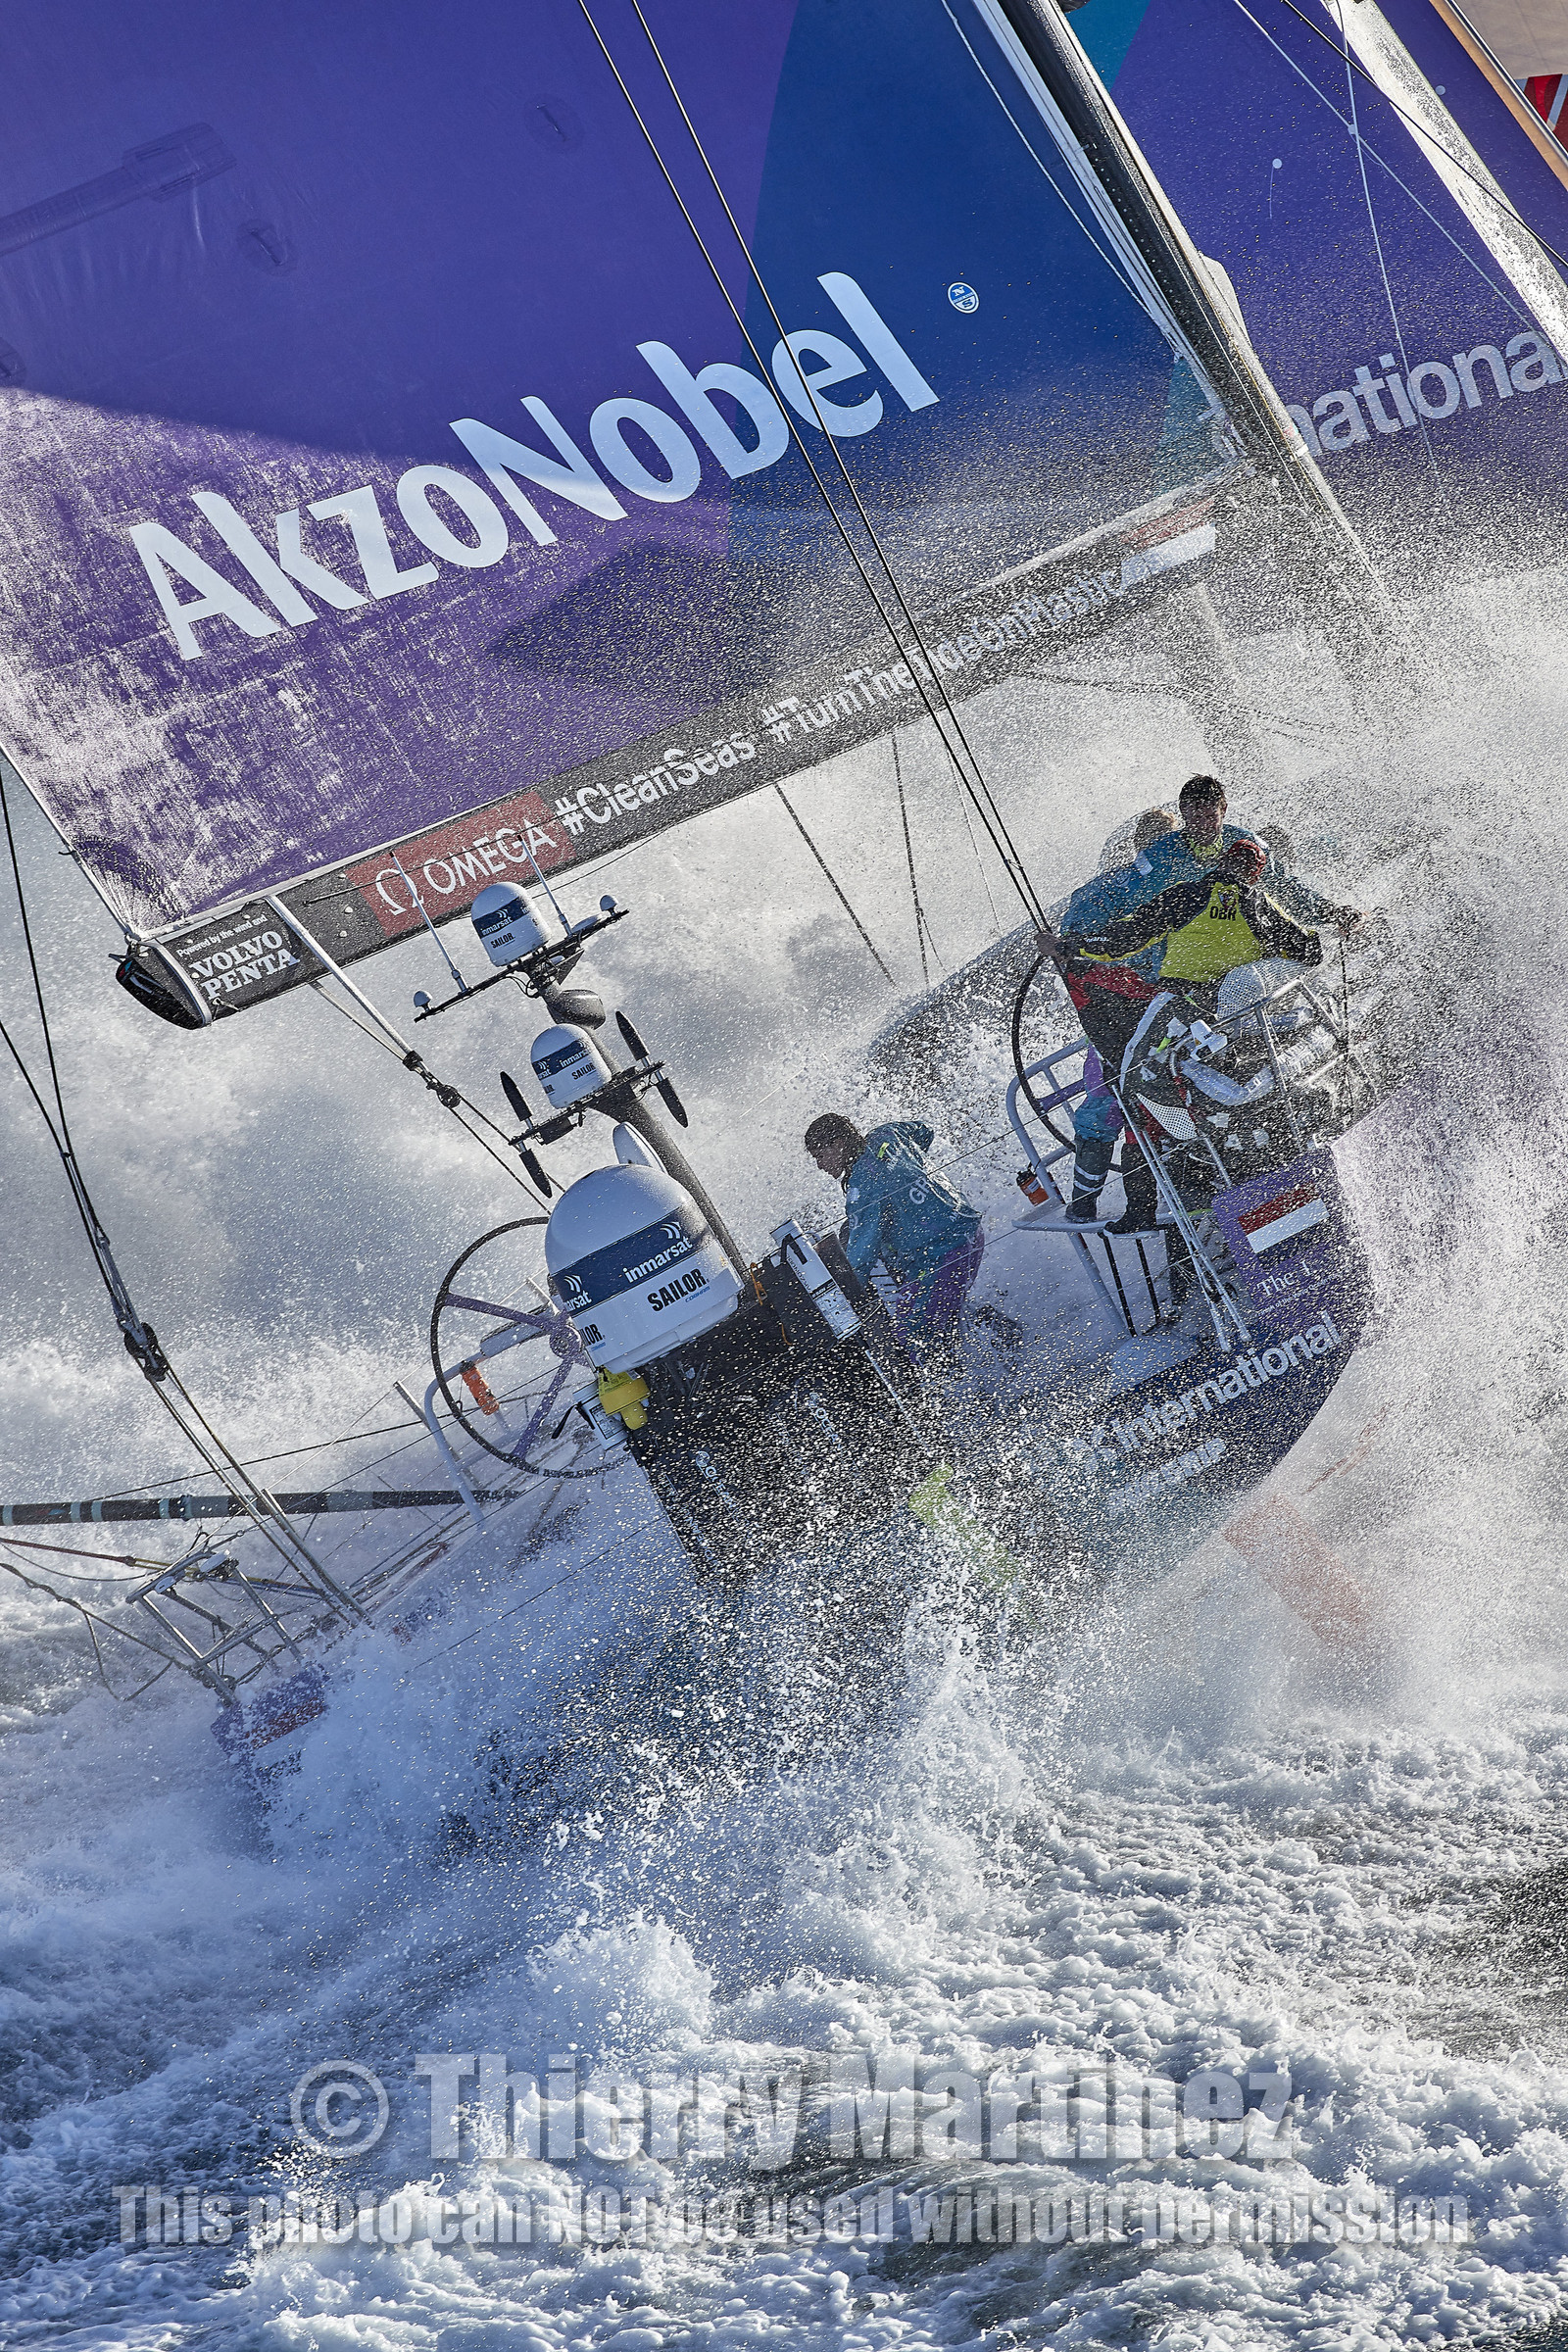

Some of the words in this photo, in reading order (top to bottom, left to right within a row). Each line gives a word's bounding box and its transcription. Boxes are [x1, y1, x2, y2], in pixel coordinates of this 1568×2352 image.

[1285, 330, 1568, 457] nationa
[129, 271, 939, 661] AkzoNobel
[423, 819, 557, 894] OMEGA
[555, 733, 756, 835] #CleanSeas
[176, 938, 212, 957] Powered
[219, 929, 235, 939] the
[233, 921, 253, 933] wind
[251, 914, 269, 926] and
[479, 915, 514, 936] inmarsat
[1209, 906, 1237, 921] OBR
[188, 931, 283, 977] VOLVO
[490, 932, 514, 949] SAILOR
[200, 949, 301, 1000] PENTA
[571, 1062, 596, 1080] SAILOR
[622, 1236, 693, 1283] inmarsat
[647, 1268, 708, 1312] SAILOR
[1256, 1273, 1295, 1296] The
[1111, 1310, 1342, 1452] International
